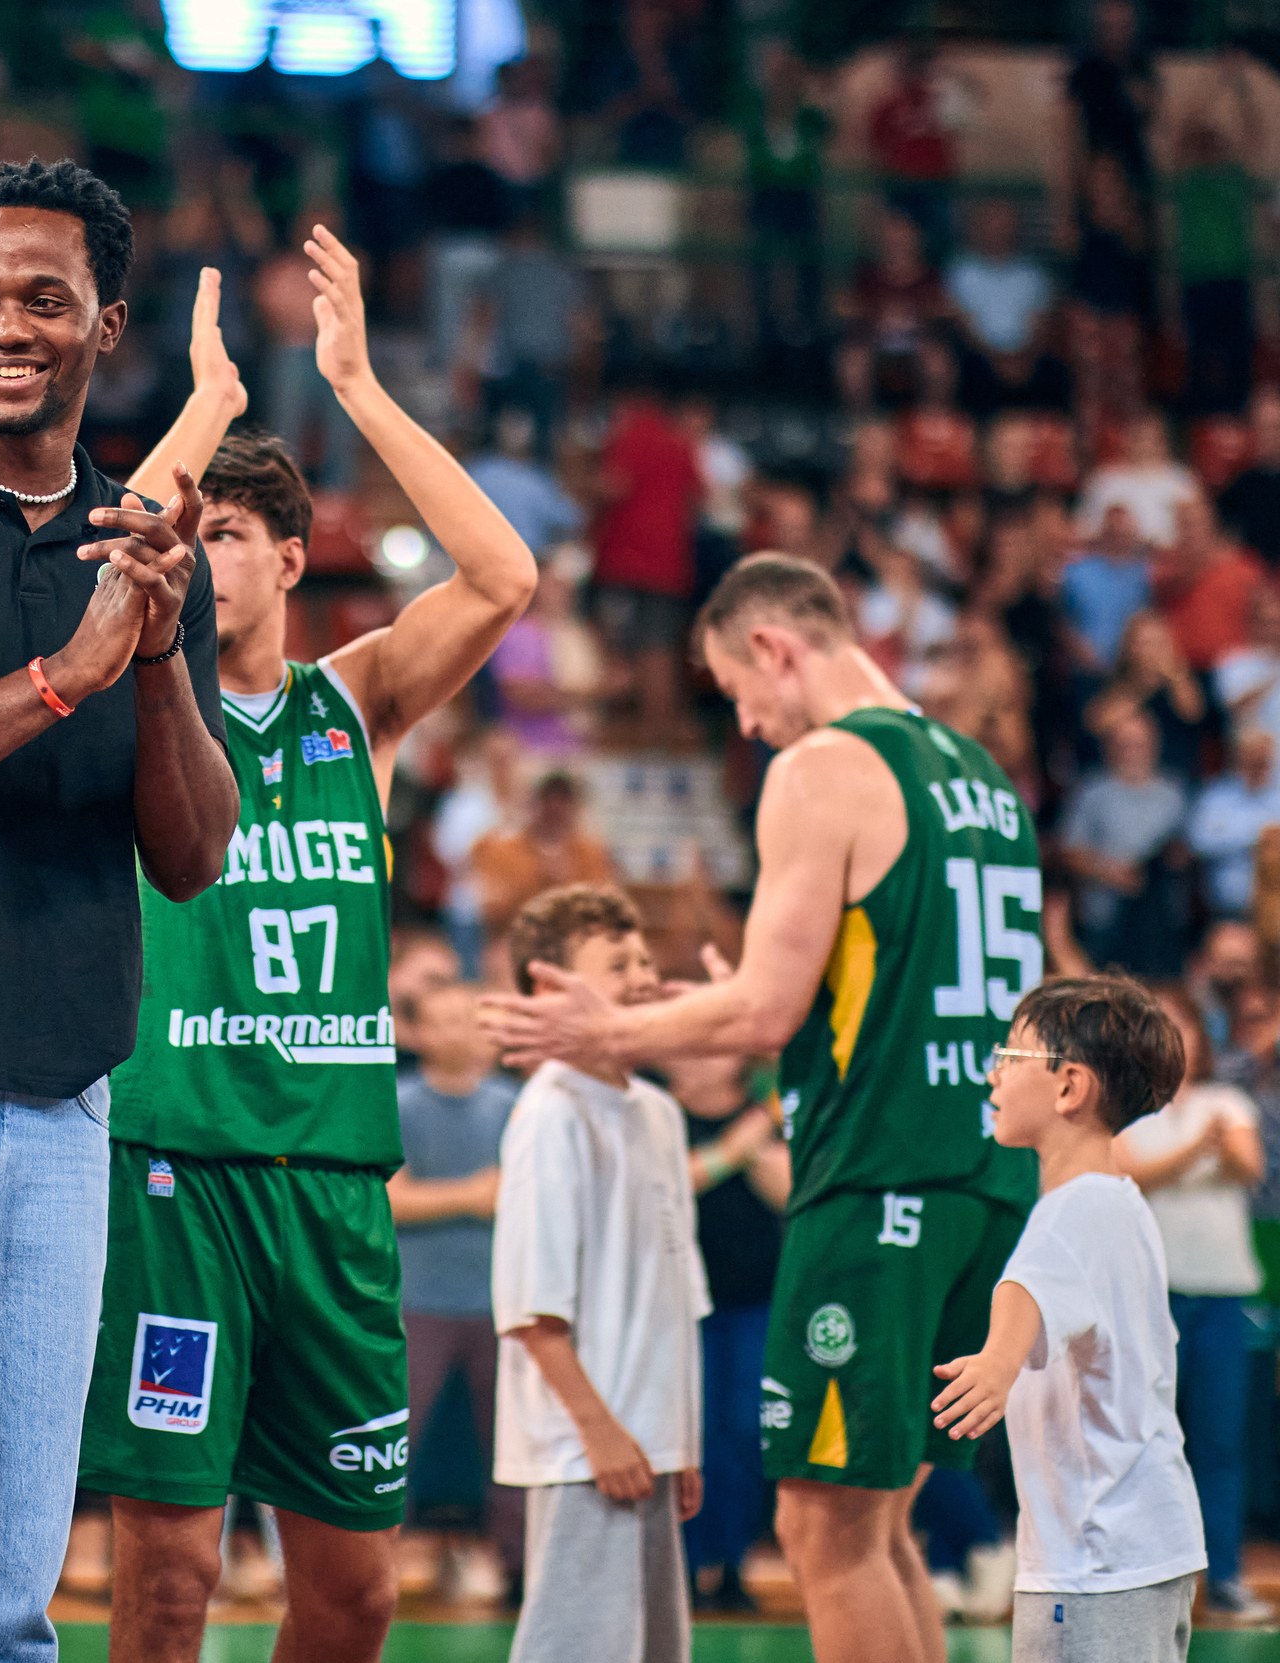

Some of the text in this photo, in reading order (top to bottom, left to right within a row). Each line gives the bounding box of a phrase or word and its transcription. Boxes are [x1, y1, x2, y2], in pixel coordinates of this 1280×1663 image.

[216, 819, 375, 885] MOGE
[249, 904, 338, 994] 87
[934, 858, 1043, 1022] 15
[878, 1192, 923, 1248] 15
[134, 1396, 202, 1418] PHM
